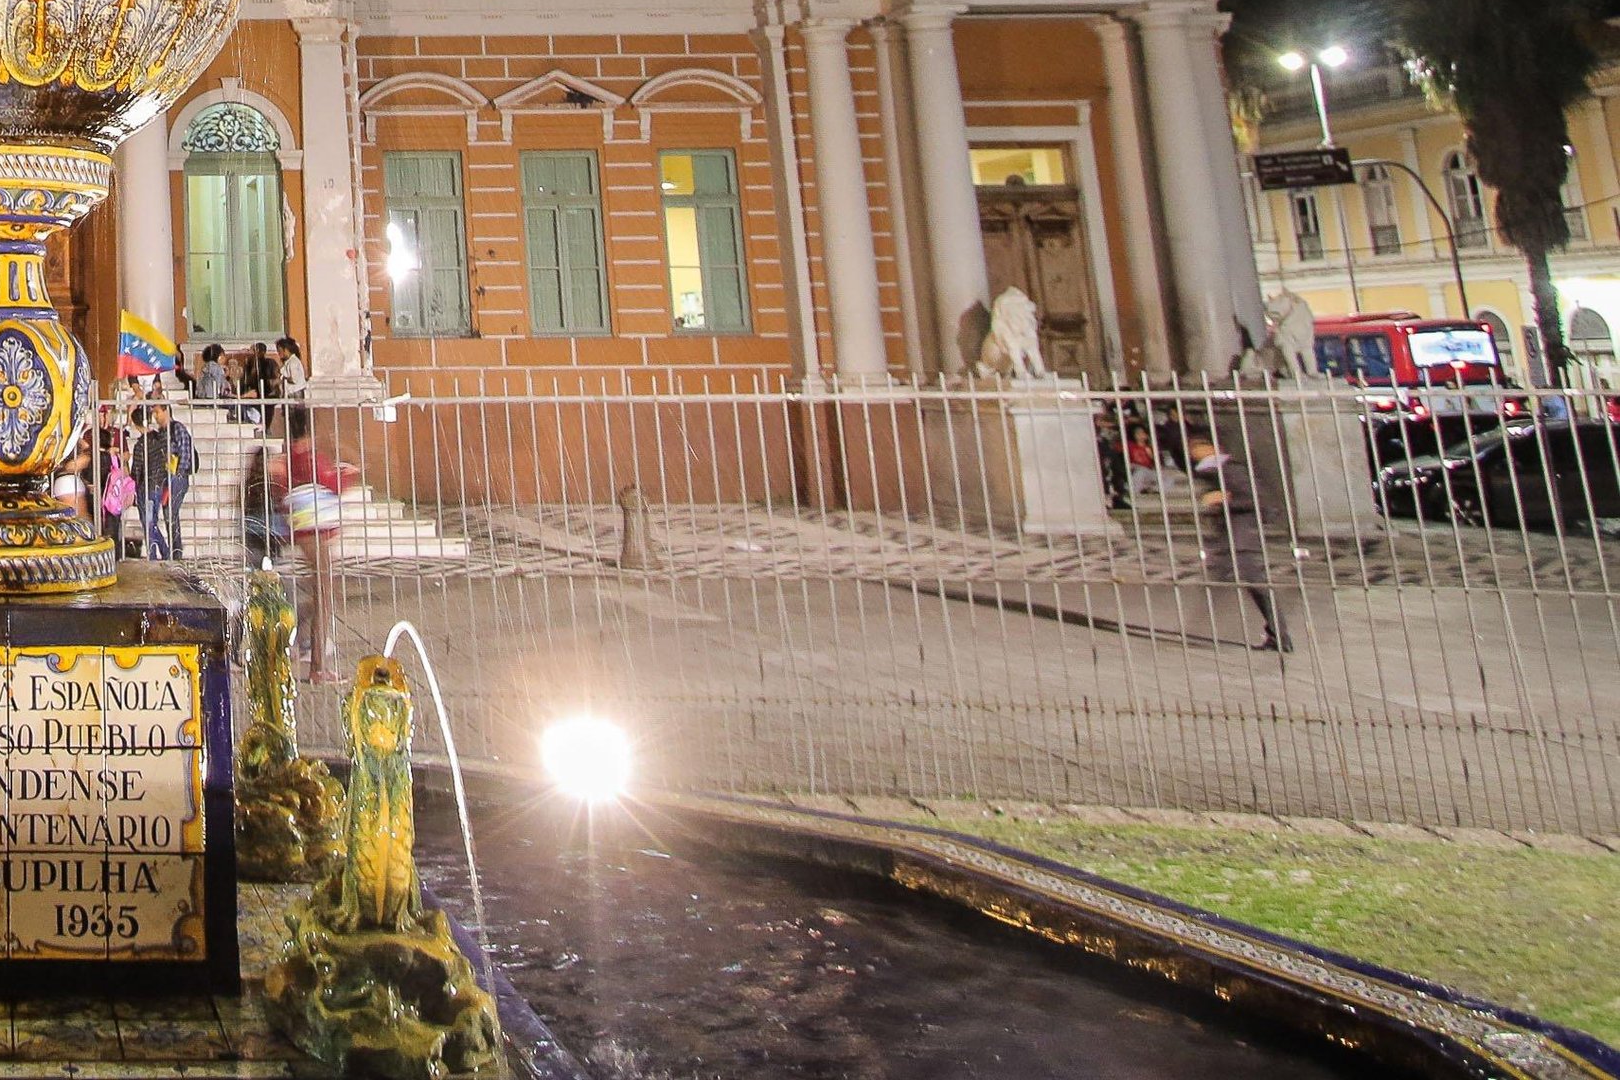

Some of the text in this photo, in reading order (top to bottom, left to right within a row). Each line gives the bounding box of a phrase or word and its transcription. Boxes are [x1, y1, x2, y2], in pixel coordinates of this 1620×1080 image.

[30, 675, 181, 711] ESPAÑOLA
[44, 720, 166, 757] PUEBLO
[56, 904, 140, 938] 1935
